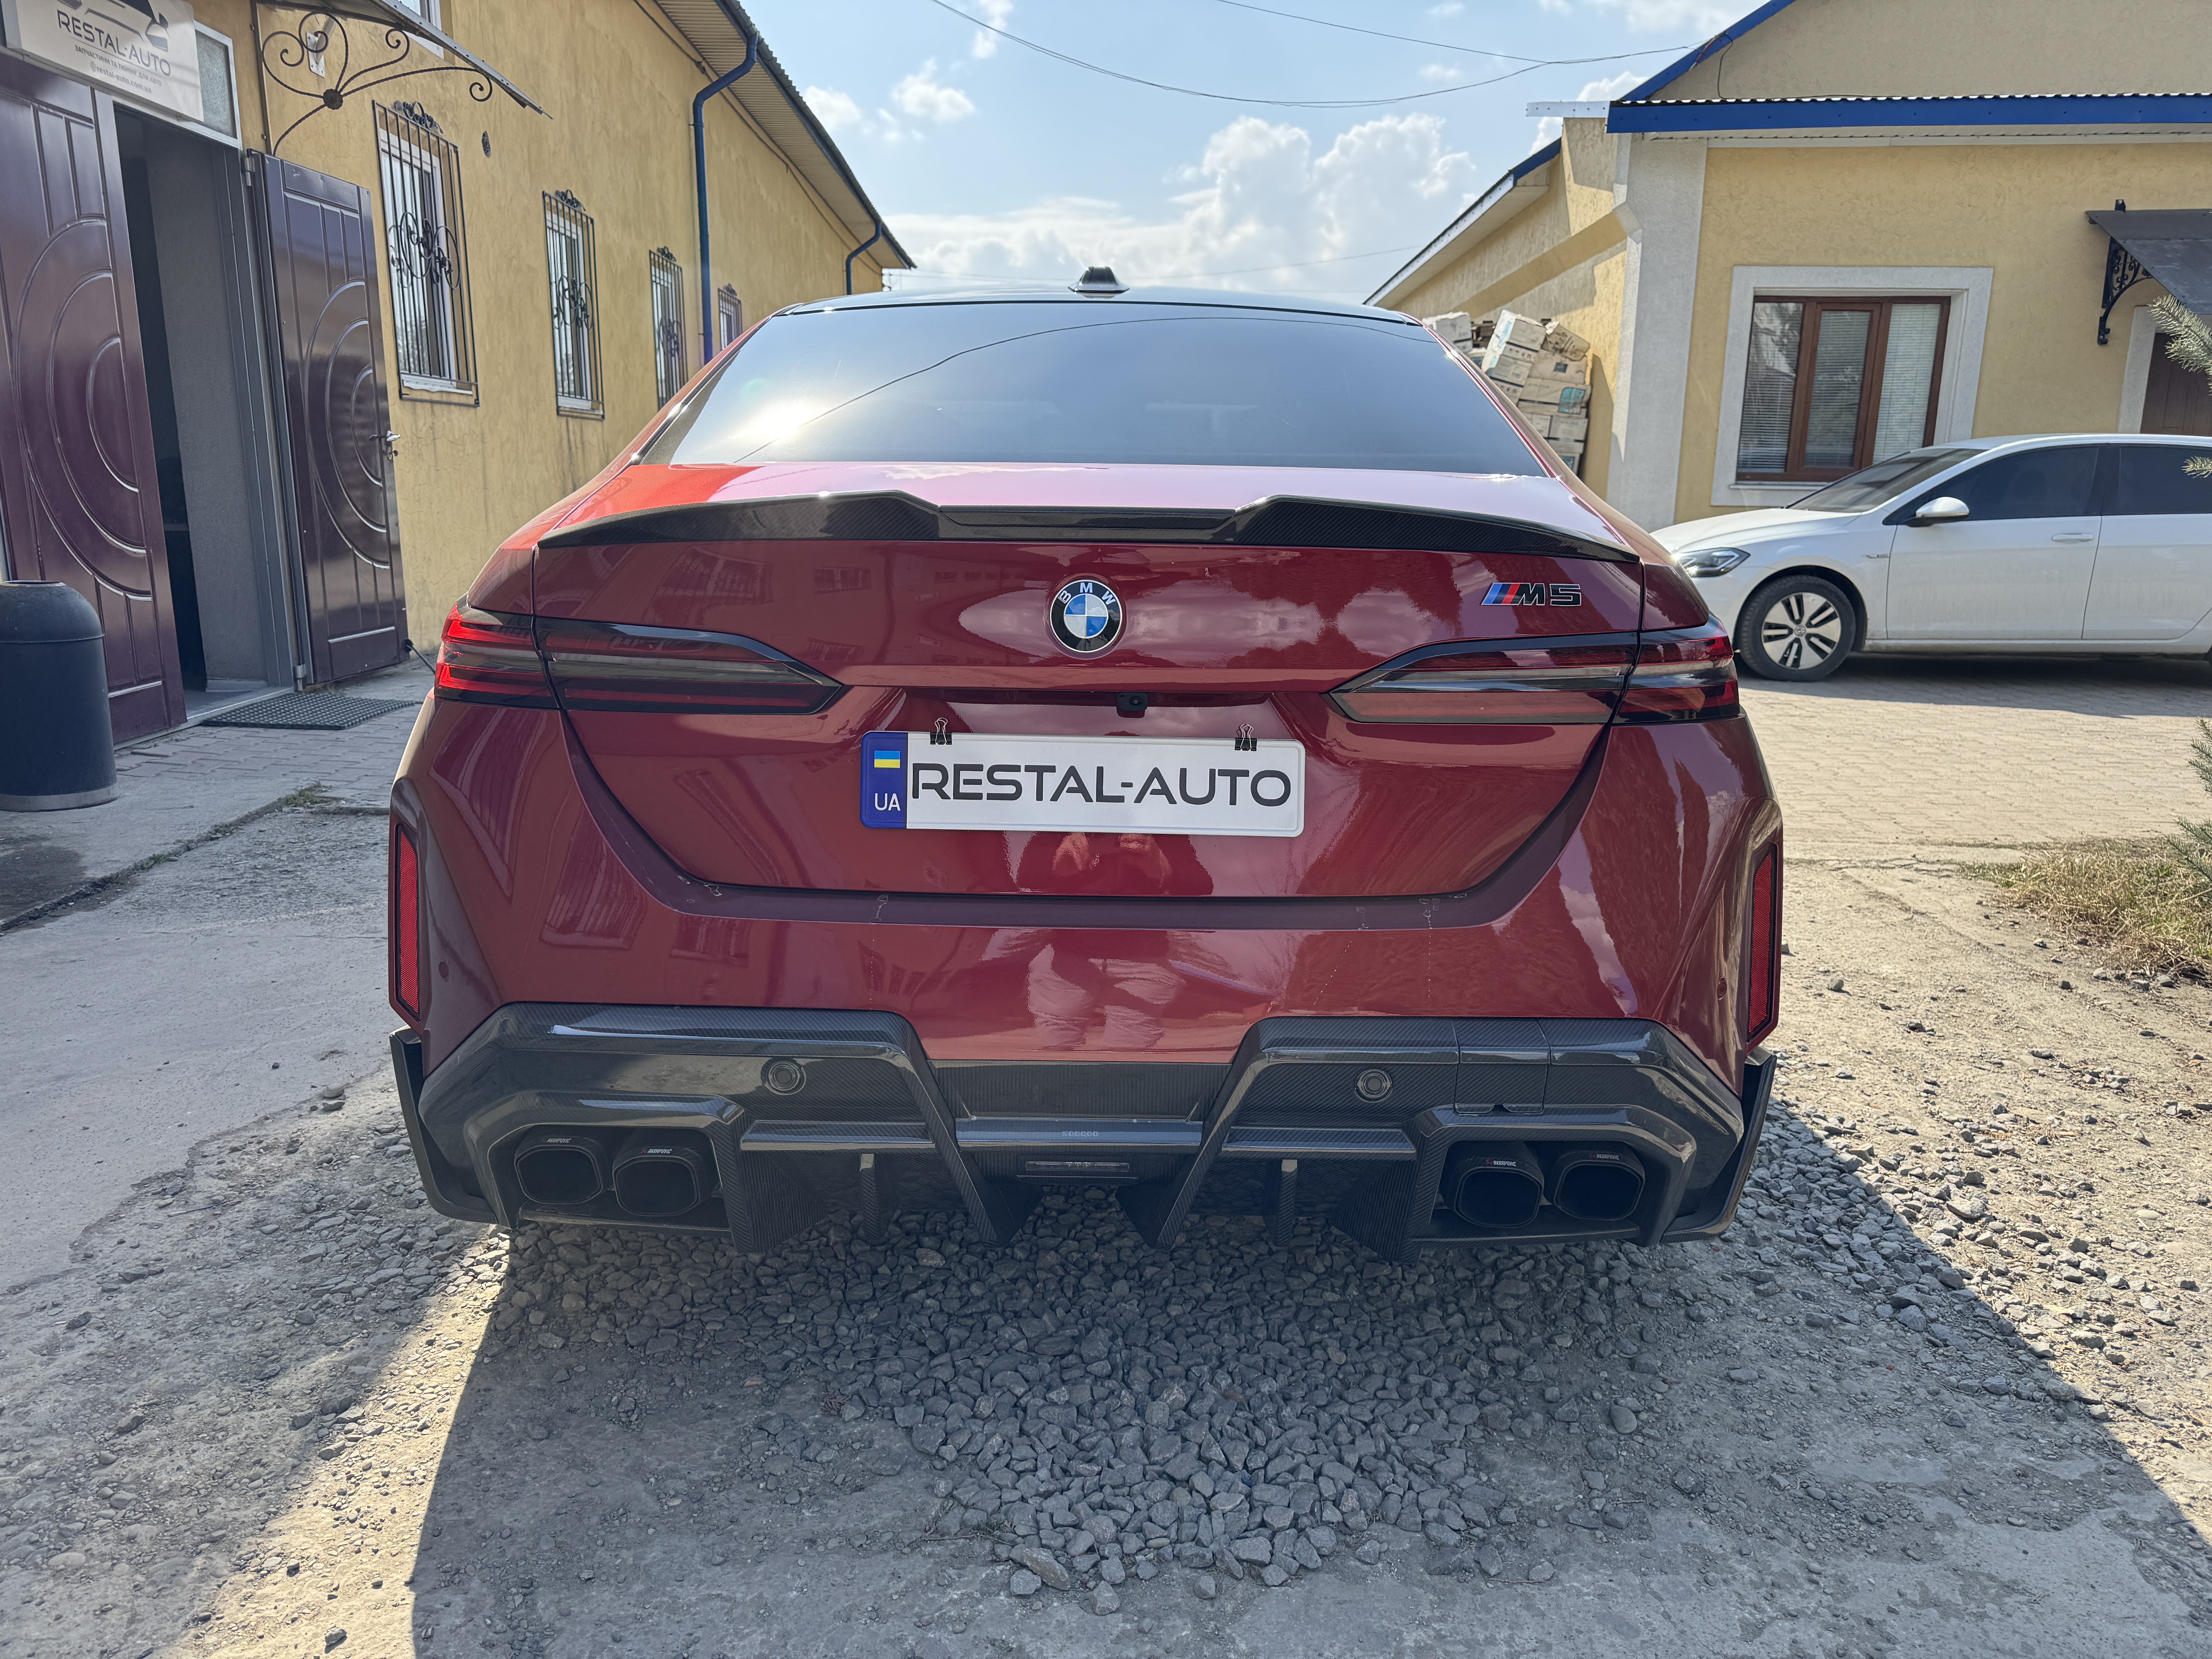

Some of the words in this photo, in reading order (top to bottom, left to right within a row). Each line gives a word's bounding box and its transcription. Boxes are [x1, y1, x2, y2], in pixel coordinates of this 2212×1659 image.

[57, 9, 171, 77] RESTAL-AUTO
[74, 45, 110, 65] ЗАПЧАСТИНИ
[111, 60, 118, 68] ТА
[150, 77, 162, 87] АВТО
[97, 66, 152, 94] restal-auto.com.ua
[1058, 582, 1116, 605] BMW
[1510, 582, 1582, 606] M5
[912, 763, 1291, 807] RESTAL-AUTO
[874, 793, 901, 811] UA
